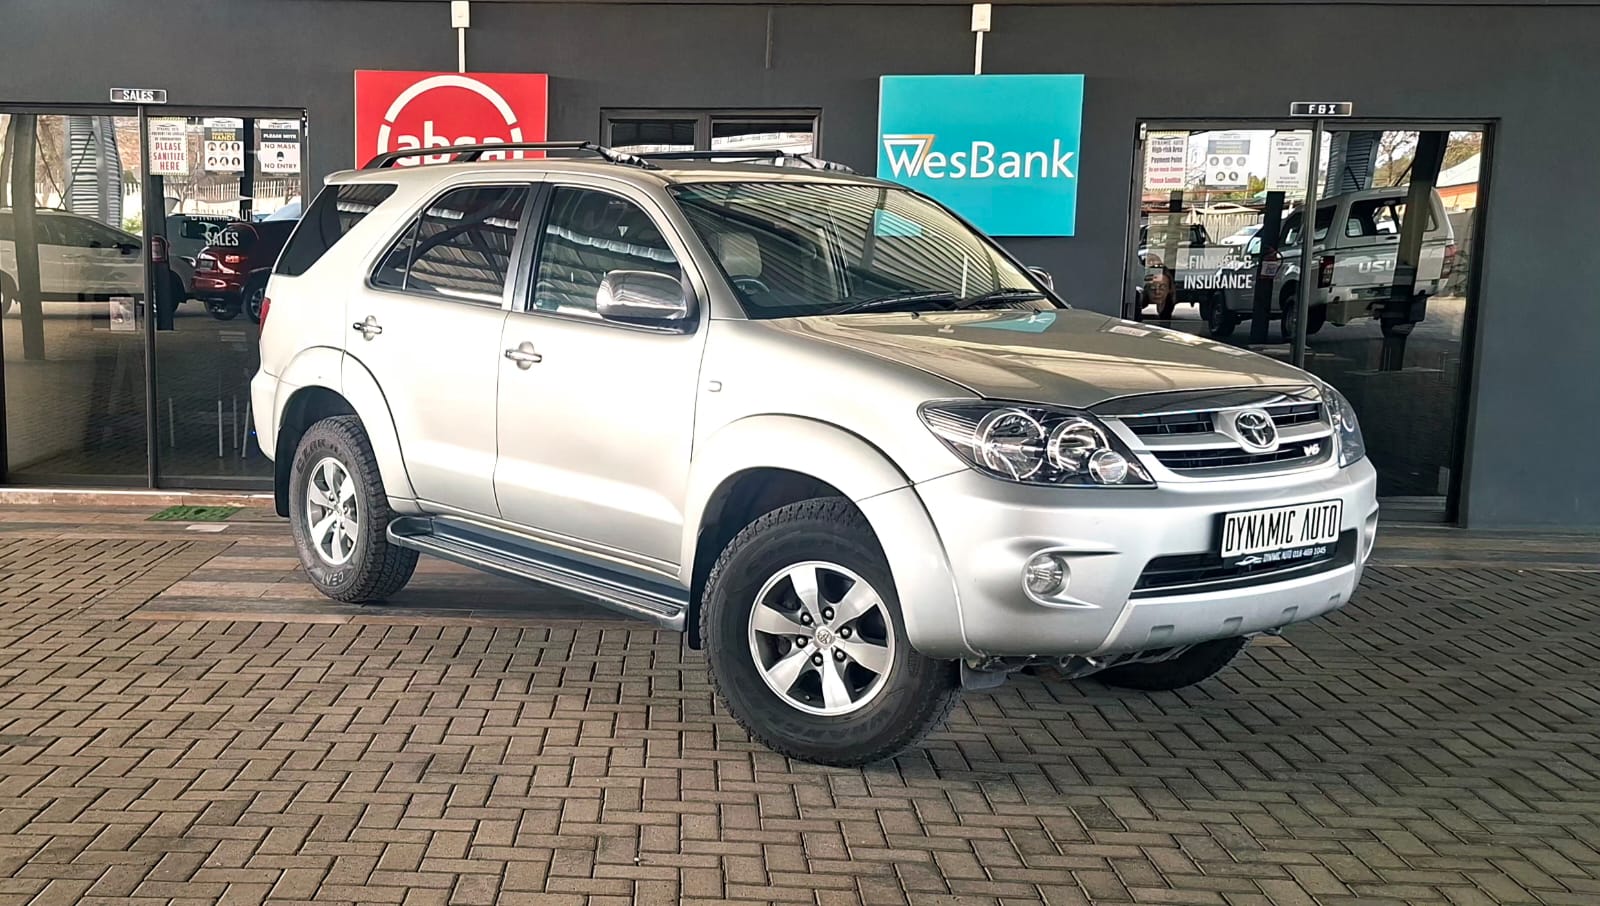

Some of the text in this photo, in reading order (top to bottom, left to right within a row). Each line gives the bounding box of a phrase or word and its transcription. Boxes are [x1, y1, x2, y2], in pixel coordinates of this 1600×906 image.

[123, 90, 154, 101] SALES
[155, 142, 182, 151] PLEASE
[153, 152, 185, 161] SANITIZE
[883, 134, 1075, 179] WesBank
[159, 161, 180, 171] HERE
[205, 231, 239, 246] SALES
[1184, 274, 1253, 290] INSURANCE
[1303, 443, 1320, 457] V6
[1225, 504, 1338, 552] DYNAMIC AUTO
